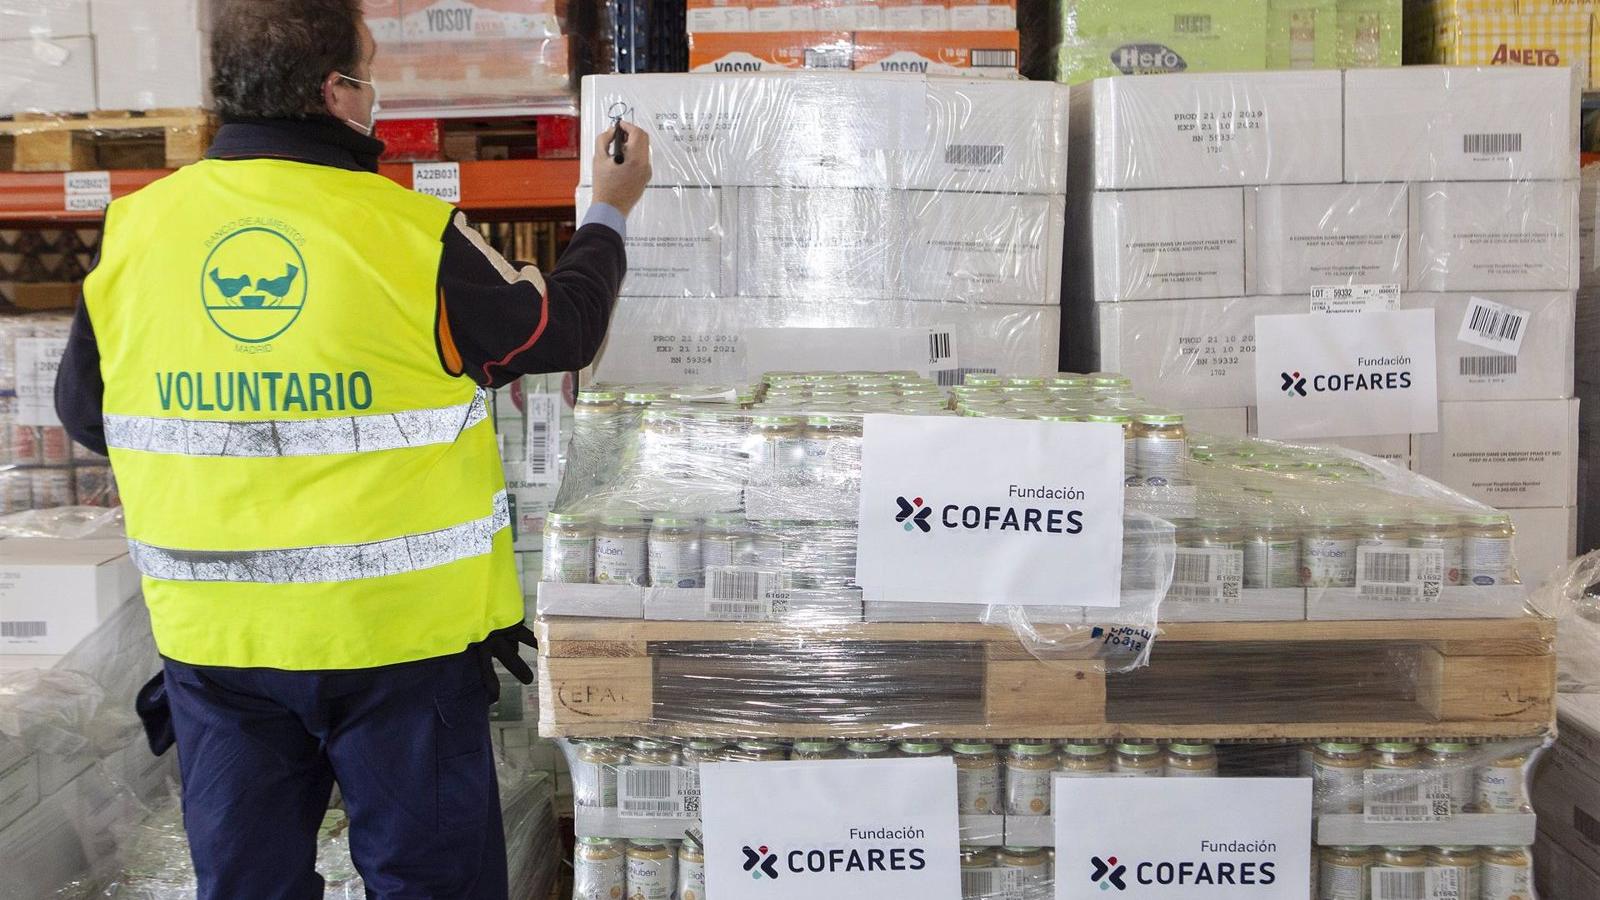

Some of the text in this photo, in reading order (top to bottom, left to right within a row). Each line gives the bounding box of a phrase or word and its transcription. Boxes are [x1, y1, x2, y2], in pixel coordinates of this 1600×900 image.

[426, 8, 473, 32] YOSOY
[1120, 46, 1178, 67] Hero
[1490, 43, 1560, 66] ANETO
[1222, 111, 1232, 119] 10
[1239, 110, 1263, 118] 2019
[1220, 122, 1231, 130] 10
[239, 216, 252, 227] DE
[1312, 289, 1323, 298] LOT
[1333, 288, 1352, 297] 59332
[653, 335, 676, 343] PROD
[1226, 335, 1236, 343] 10
[234, 344, 273, 355] MADRID
[679, 345, 690, 353] 21
[696, 345, 707, 353] 10
[713, 345, 736, 353] 2021
[671, 356, 682, 364] BN
[1213, 356, 1239, 365] 59332
[1357, 355, 1411, 367] Fundación
[1313, 371, 1412, 392] COFARES
[155, 370, 373, 412] VOLUNTARIO
[1009, 484, 1085, 501] Fundación
[942, 504, 1083, 534] COFARES
[850, 826, 925, 840] Fundación
[1200, 839, 1277, 853] Fundación
[788, 848, 926, 873] COFARES
[1136, 861, 1276, 885] COFARES
